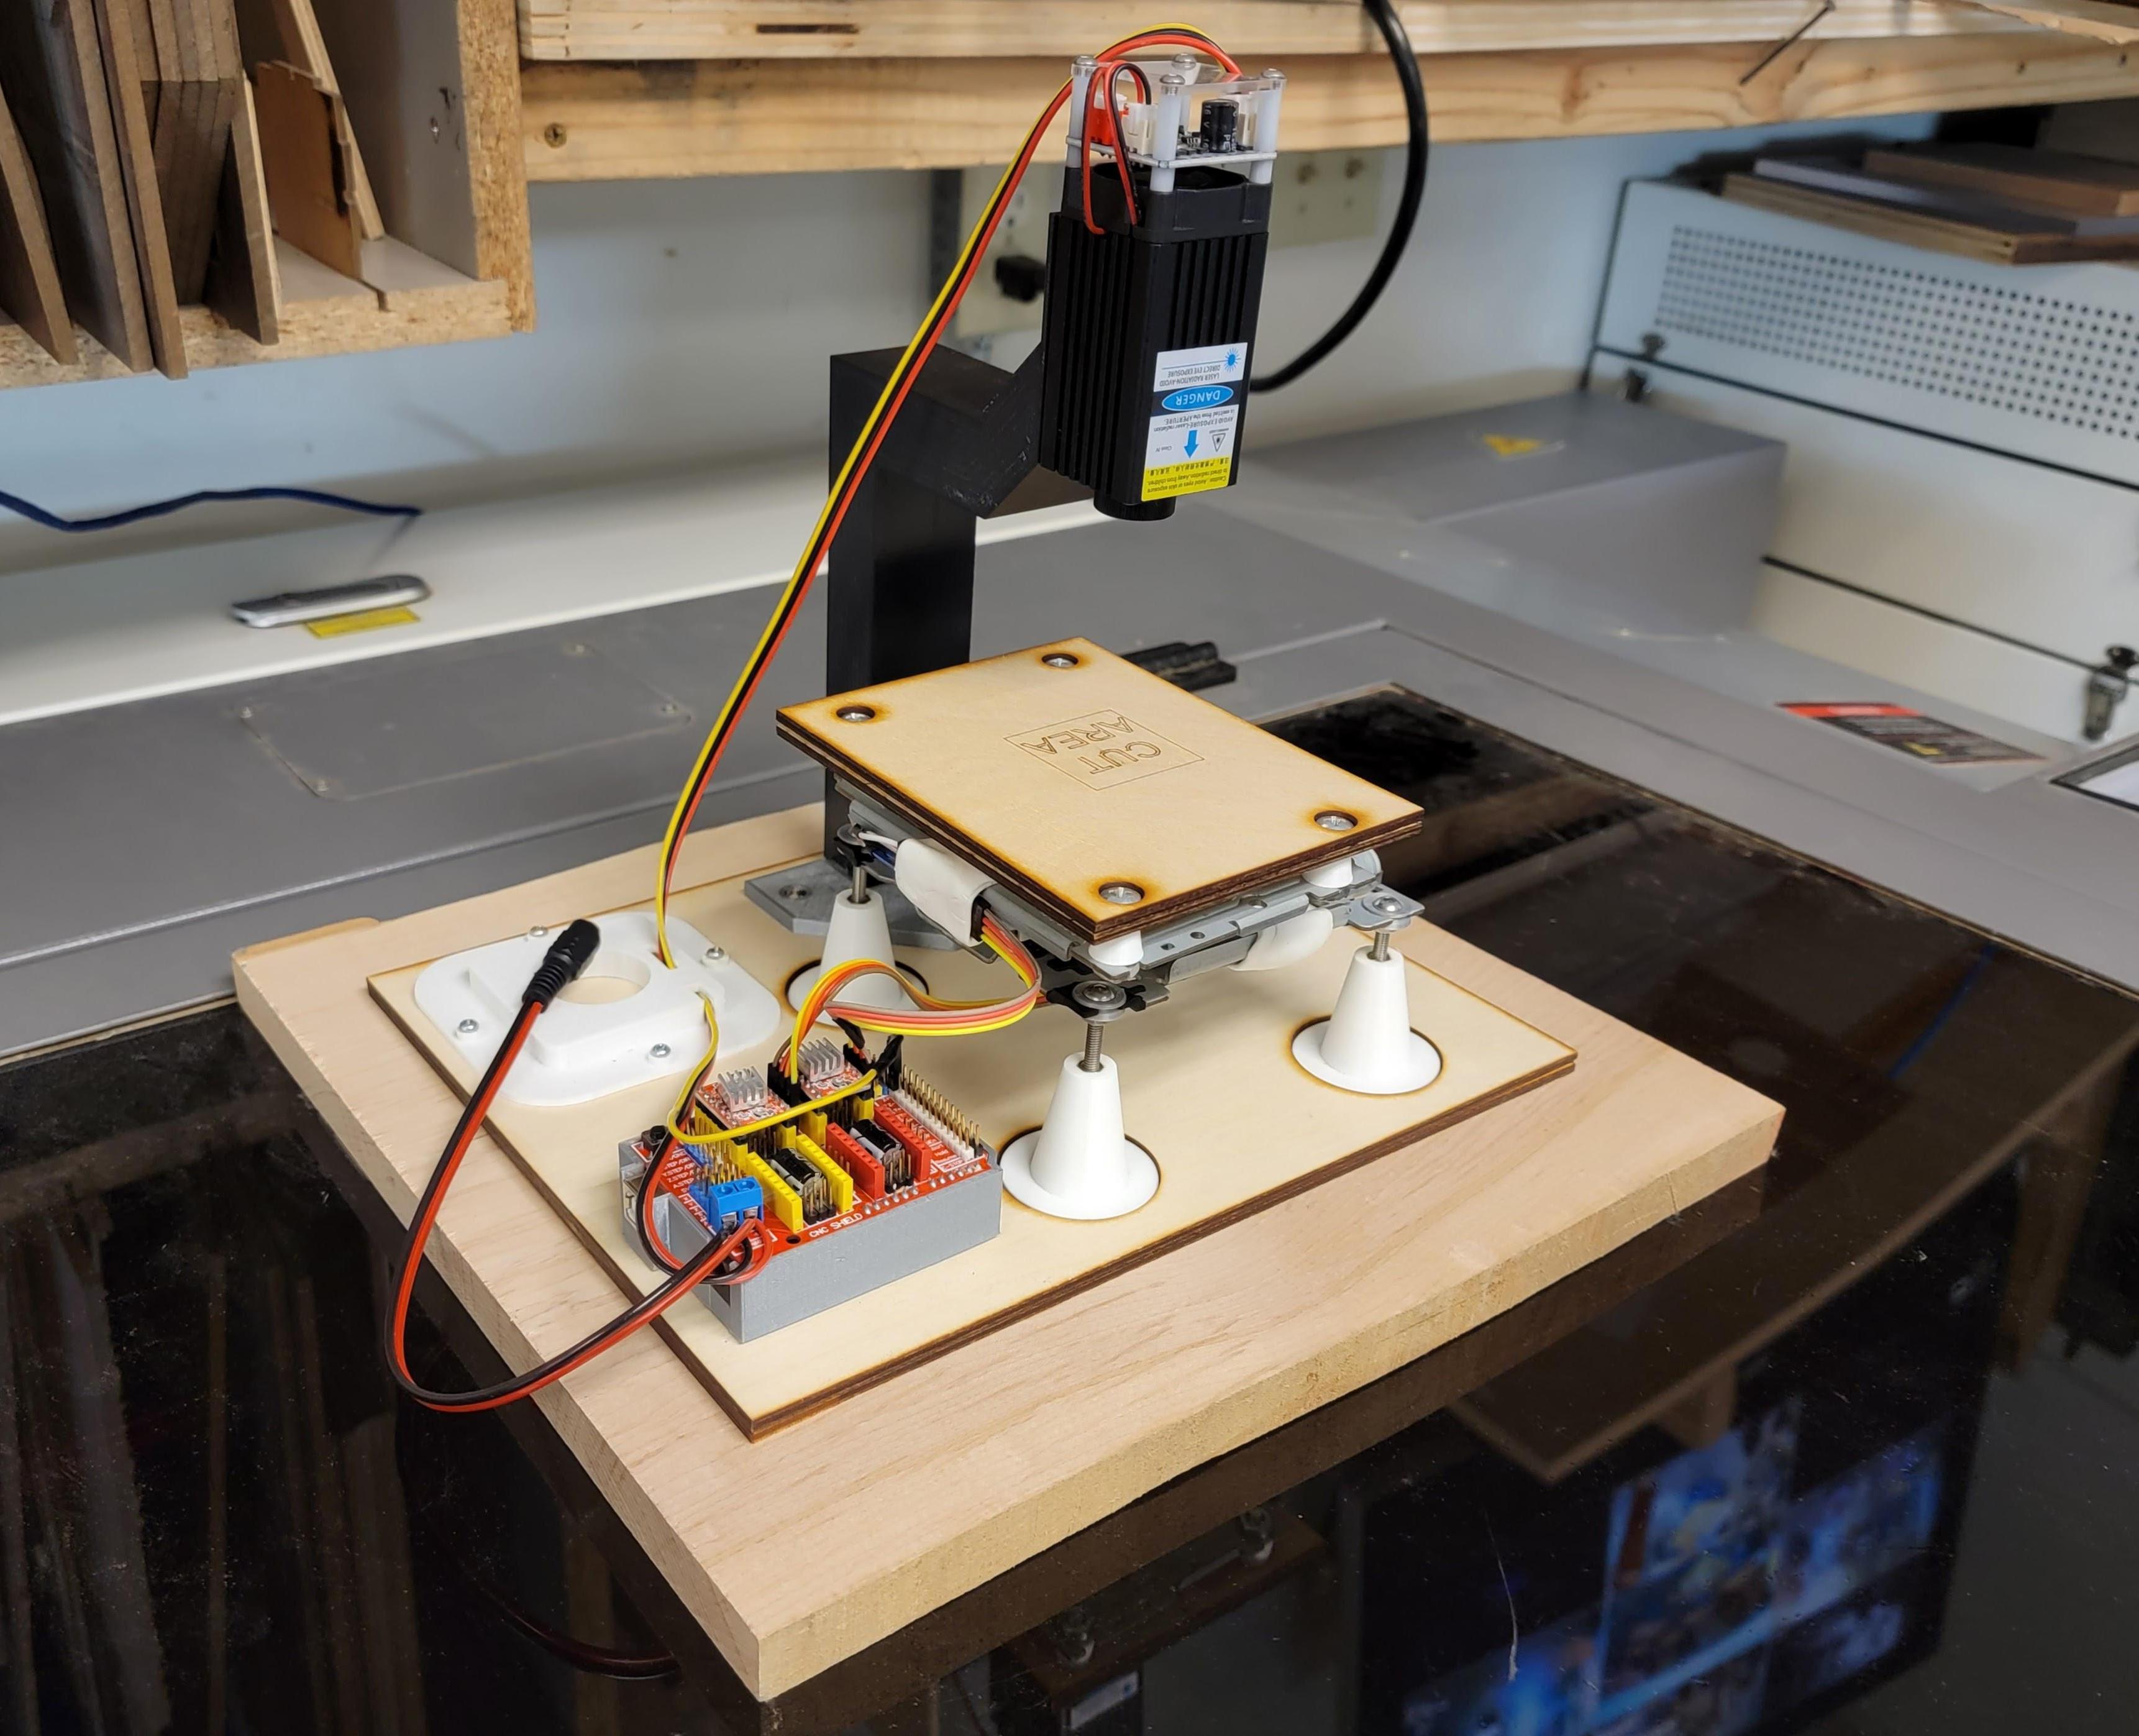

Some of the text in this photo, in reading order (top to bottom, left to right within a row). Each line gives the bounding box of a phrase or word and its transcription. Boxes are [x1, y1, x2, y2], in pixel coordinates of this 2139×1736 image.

[1167, 368, 1193, 377] EXPOSURE
[1175, 390, 1220, 406] DANGER
[1020, 716, 1134, 756] AREA
[1077, 741, 1161, 775] CUT
[809, 1212, 863, 1238] CNC SHIELD
